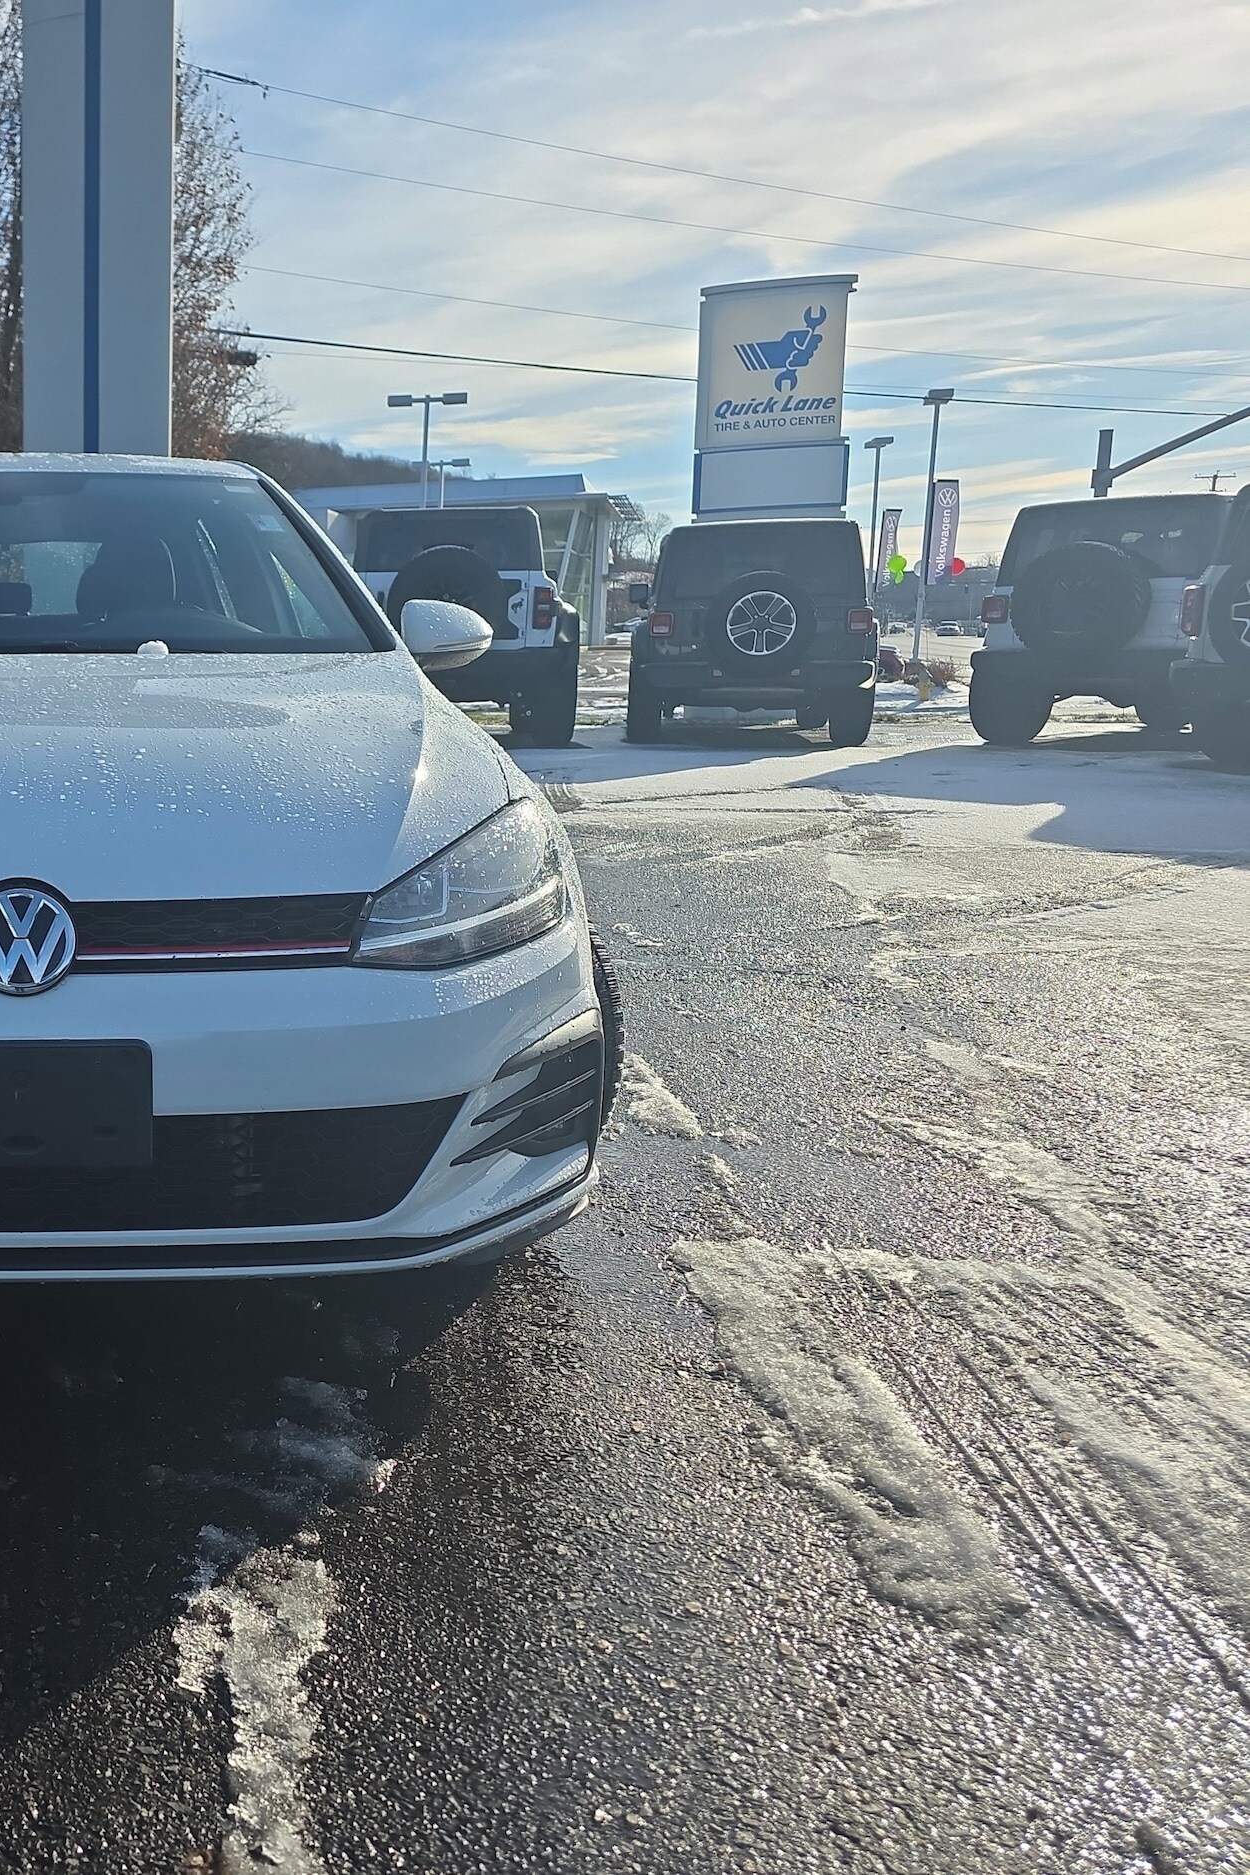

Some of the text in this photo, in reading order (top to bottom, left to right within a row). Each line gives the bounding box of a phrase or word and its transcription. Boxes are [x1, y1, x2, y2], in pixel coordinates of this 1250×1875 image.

[714, 395, 837, 419] Quick Lane
[714, 415, 836, 432] TIRE & AUTO CENTER
[934, 509, 952, 577] Volkswagen
